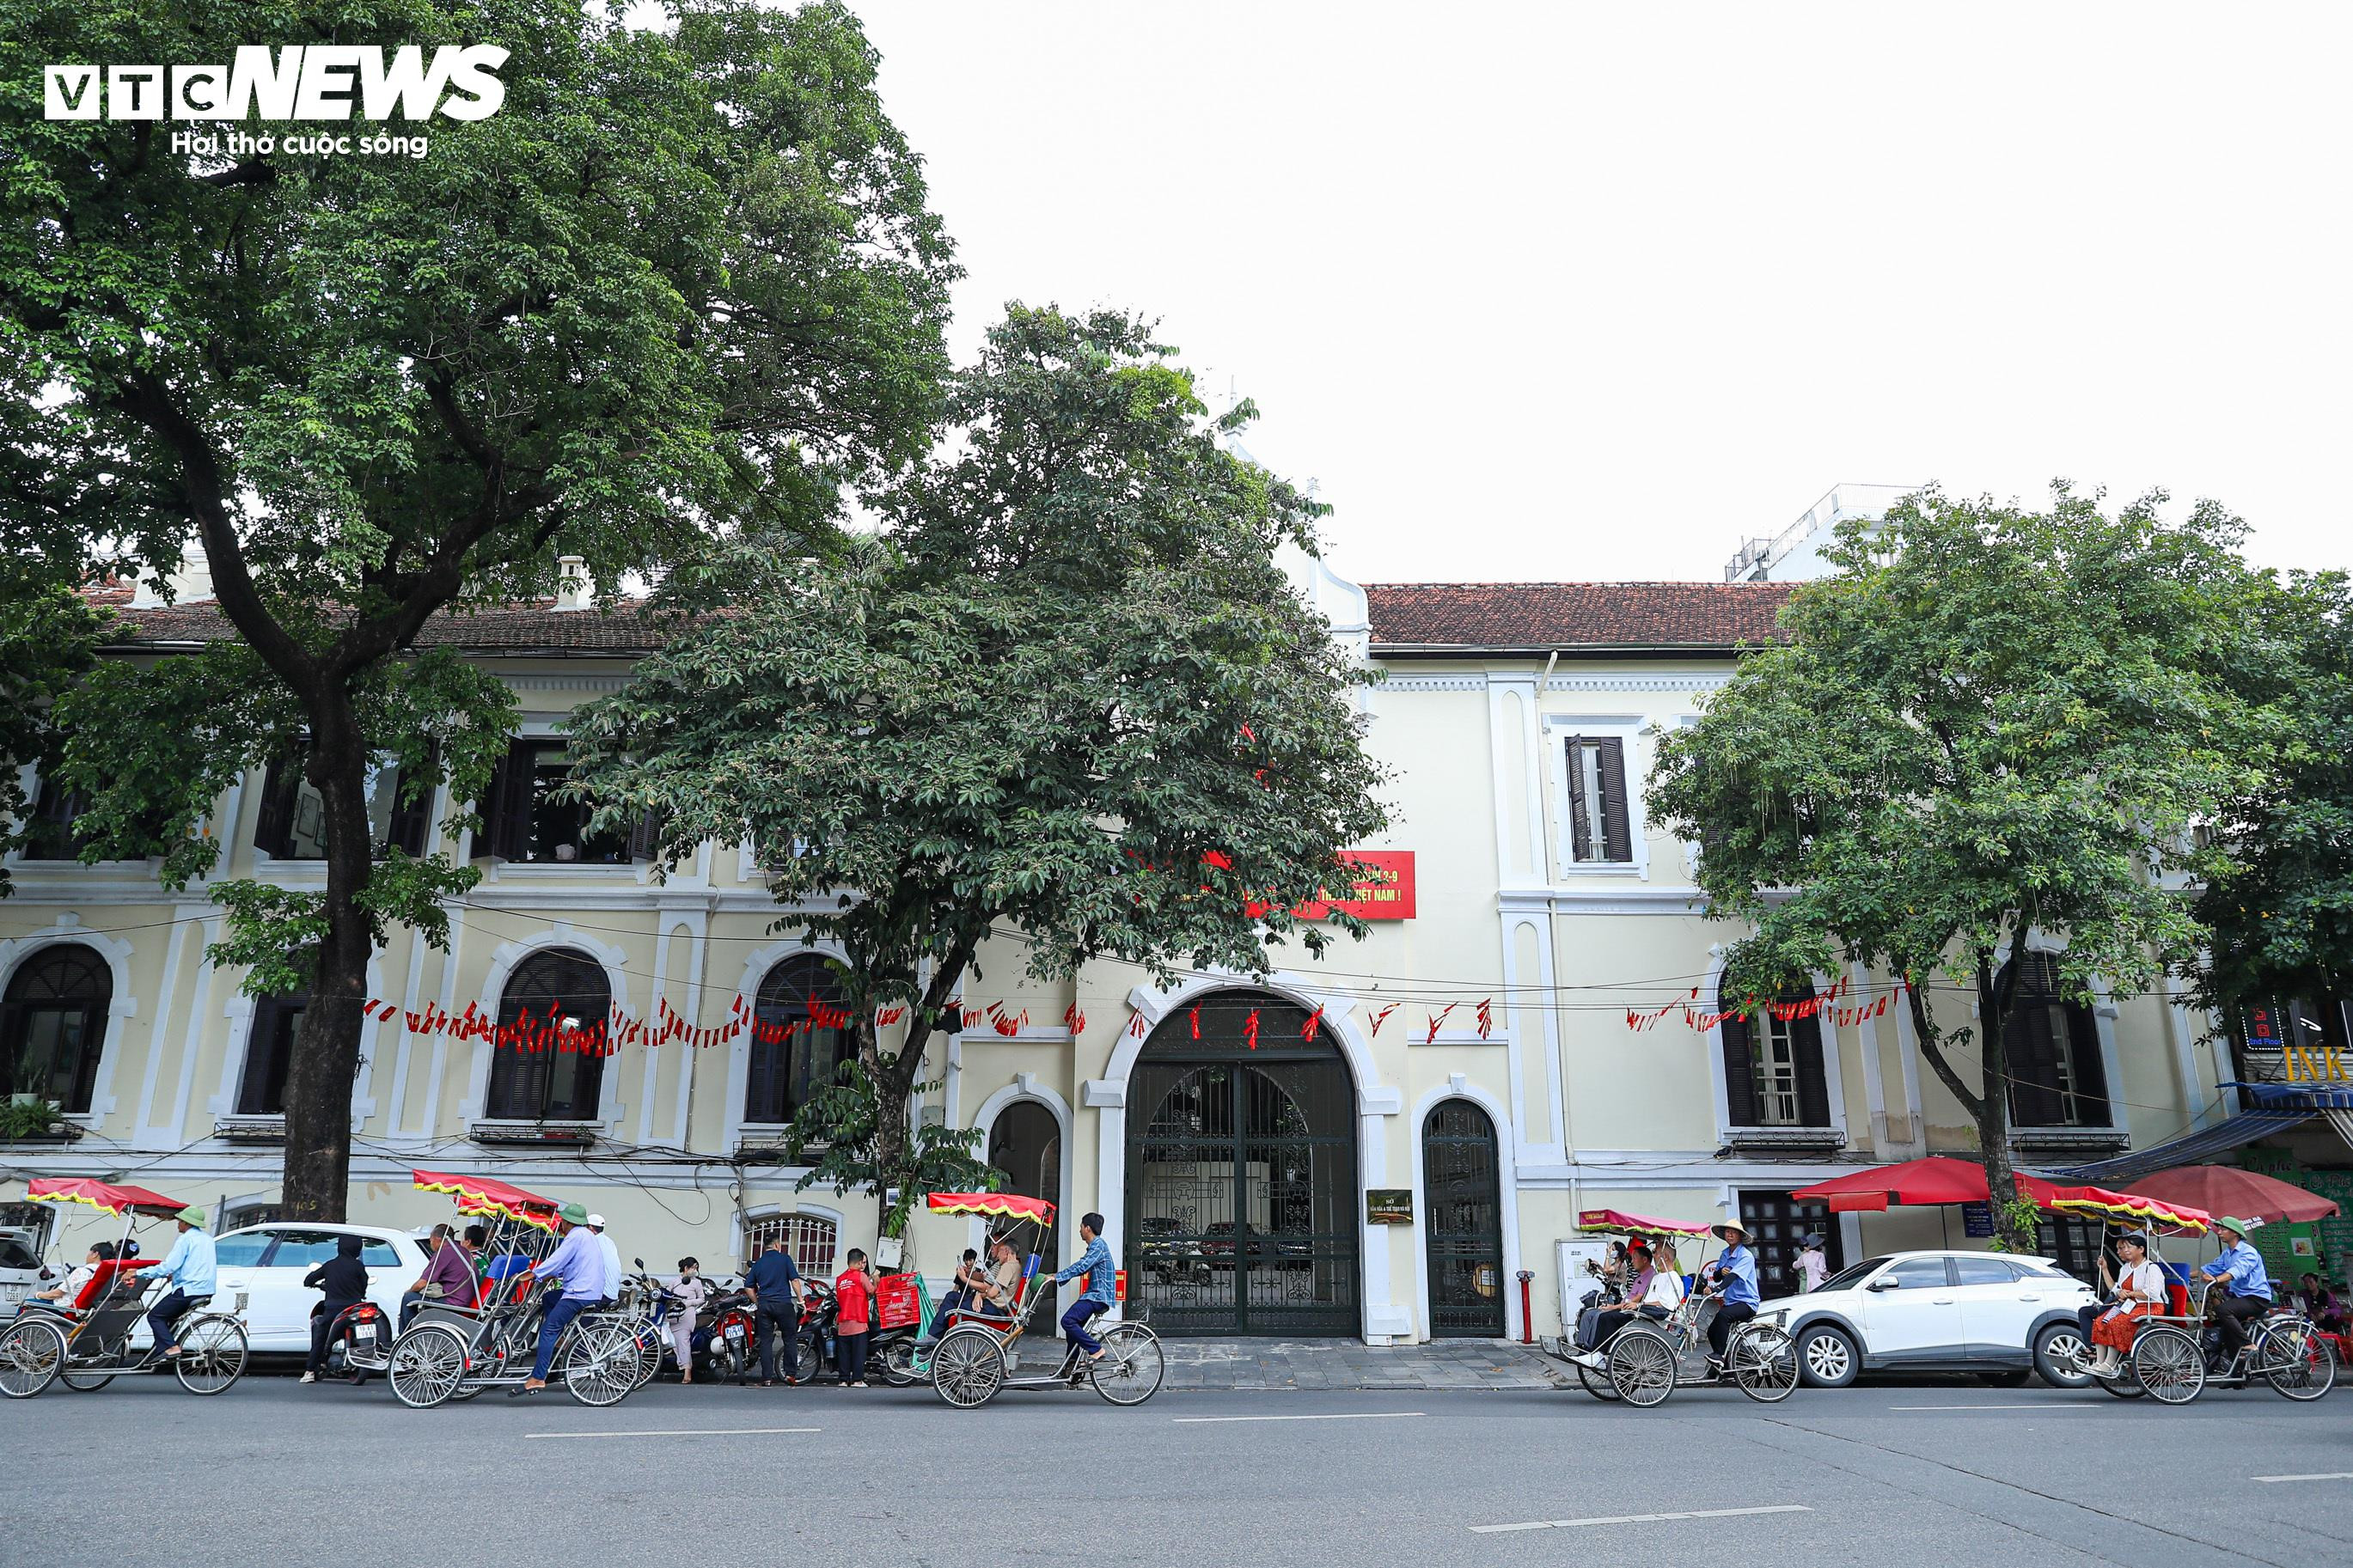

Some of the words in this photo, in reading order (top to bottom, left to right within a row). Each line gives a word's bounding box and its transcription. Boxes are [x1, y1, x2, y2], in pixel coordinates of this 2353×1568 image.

[1383, 869, 1398, 882] 2-9
[1354, 886, 1372, 904] VIỆT
[1374, 888, 1396, 901] NAM
